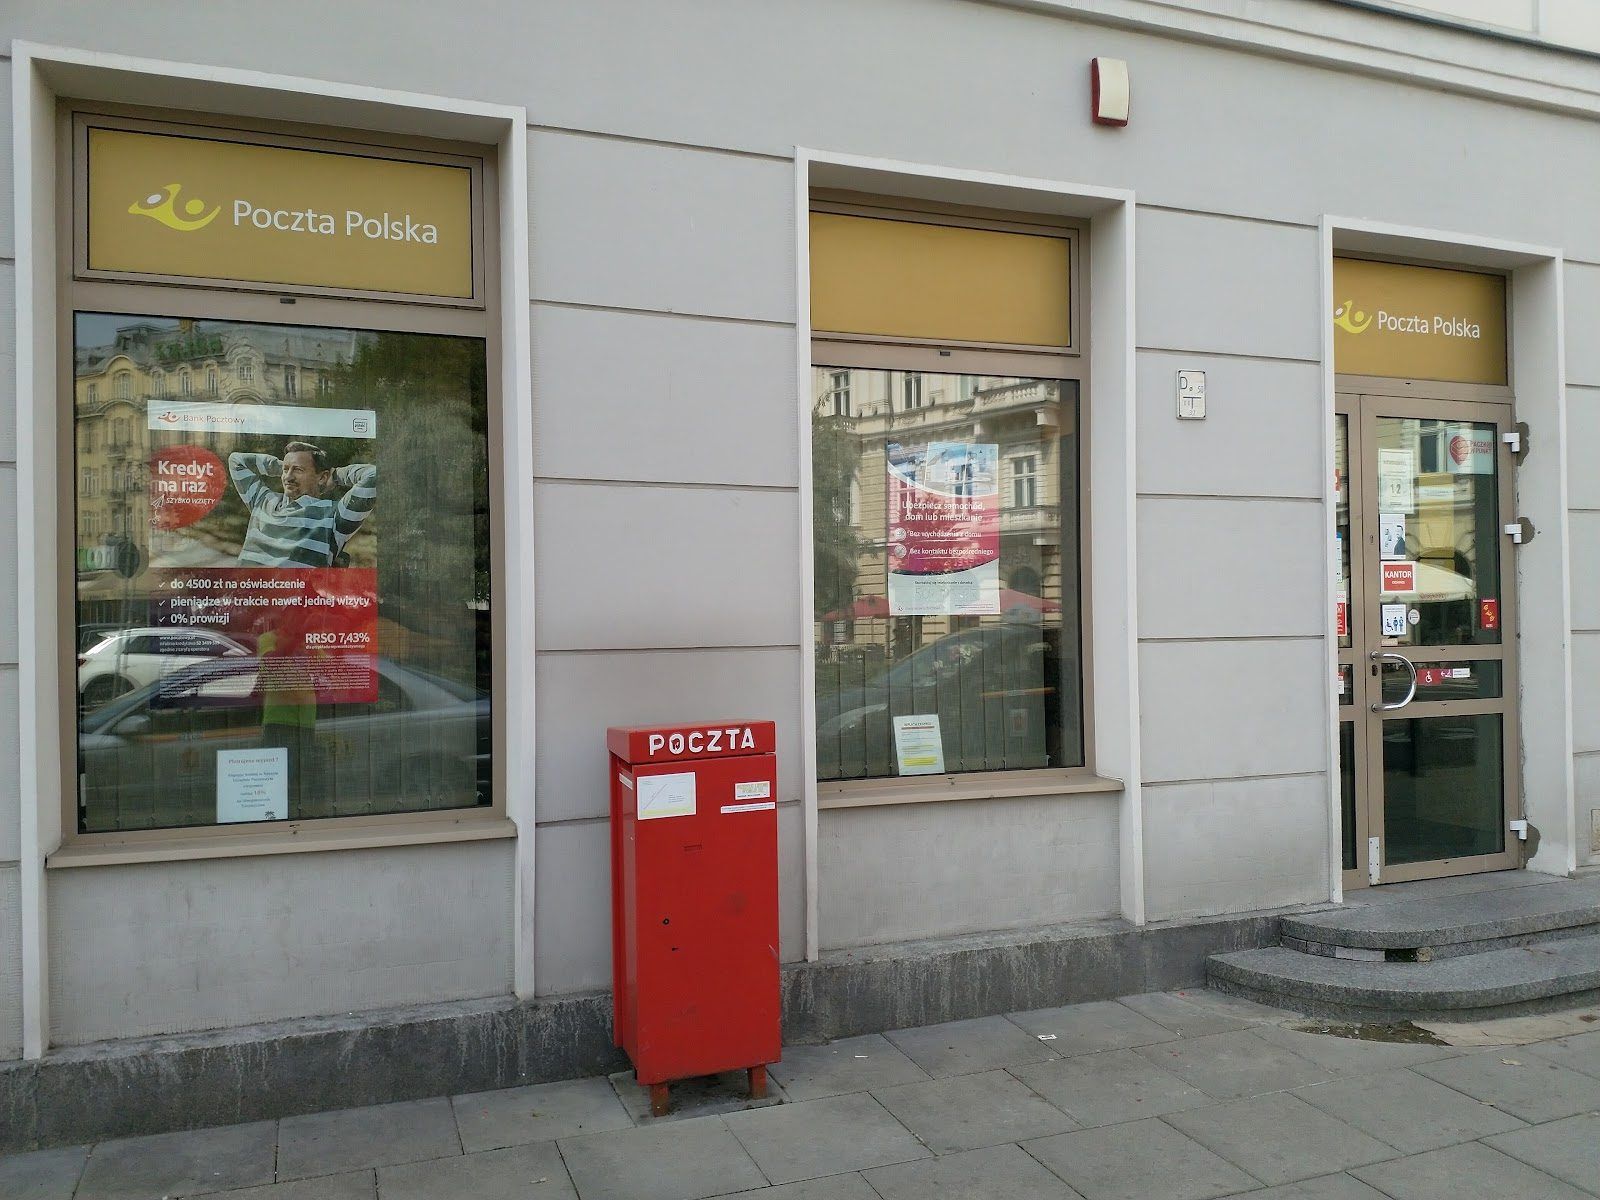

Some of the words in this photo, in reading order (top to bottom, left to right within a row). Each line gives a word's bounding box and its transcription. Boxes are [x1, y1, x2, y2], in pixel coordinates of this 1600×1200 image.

[233, 200, 335, 234] Poczta
[346, 210, 438, 243] Polska
[1378, 311, 1429, 333] Poczta
[1434, 316, 1480, 338] Polska
[183, 414, 204, 422] Bank
[206, 415, 245, 424] Pocztowy
[158, 460, 214, 479] Kredyt
[158, 480, 177, 492] na
[182, 480, 207, 493] raz
[191, 498, 216, 506] WZIĘTY
[902, 501, 942, 512] Ubezpiecz
[943, 500, 986, 511] samochód,
[905, 513, 924, 521] dom
[925, 512, 938, 521] lub
[939, 513, 983, 522] mieszkanie
[948, 548, 994, 556] bezpośredniego
[1385, 570, 1412, 579] KANTOR
[170, 579, 184, 589] do
[186, 579, 211, 589] 4500
[213, 579, 223, 589] zł
[225, 580, 238, 589] na
[239, 578, 306, 589] oświadczenie
[170, 596, 220, 608] pieniądze
[222, 598, 232, 606] w
[234, 596, 269, 606] trakcie
[271, 597, 303, 606] nawet
[304, 596, 335, 608] jednej
[337, 597, 370, 608] wizyty
[170, 613, 188, 624] 0%
[190, 613, 230, 625] prowizji
[305, 632, 337, 643] RRSO
[338, 632, 370, 645] 7,43%
[649, 728, 755, 756] POCZTA
